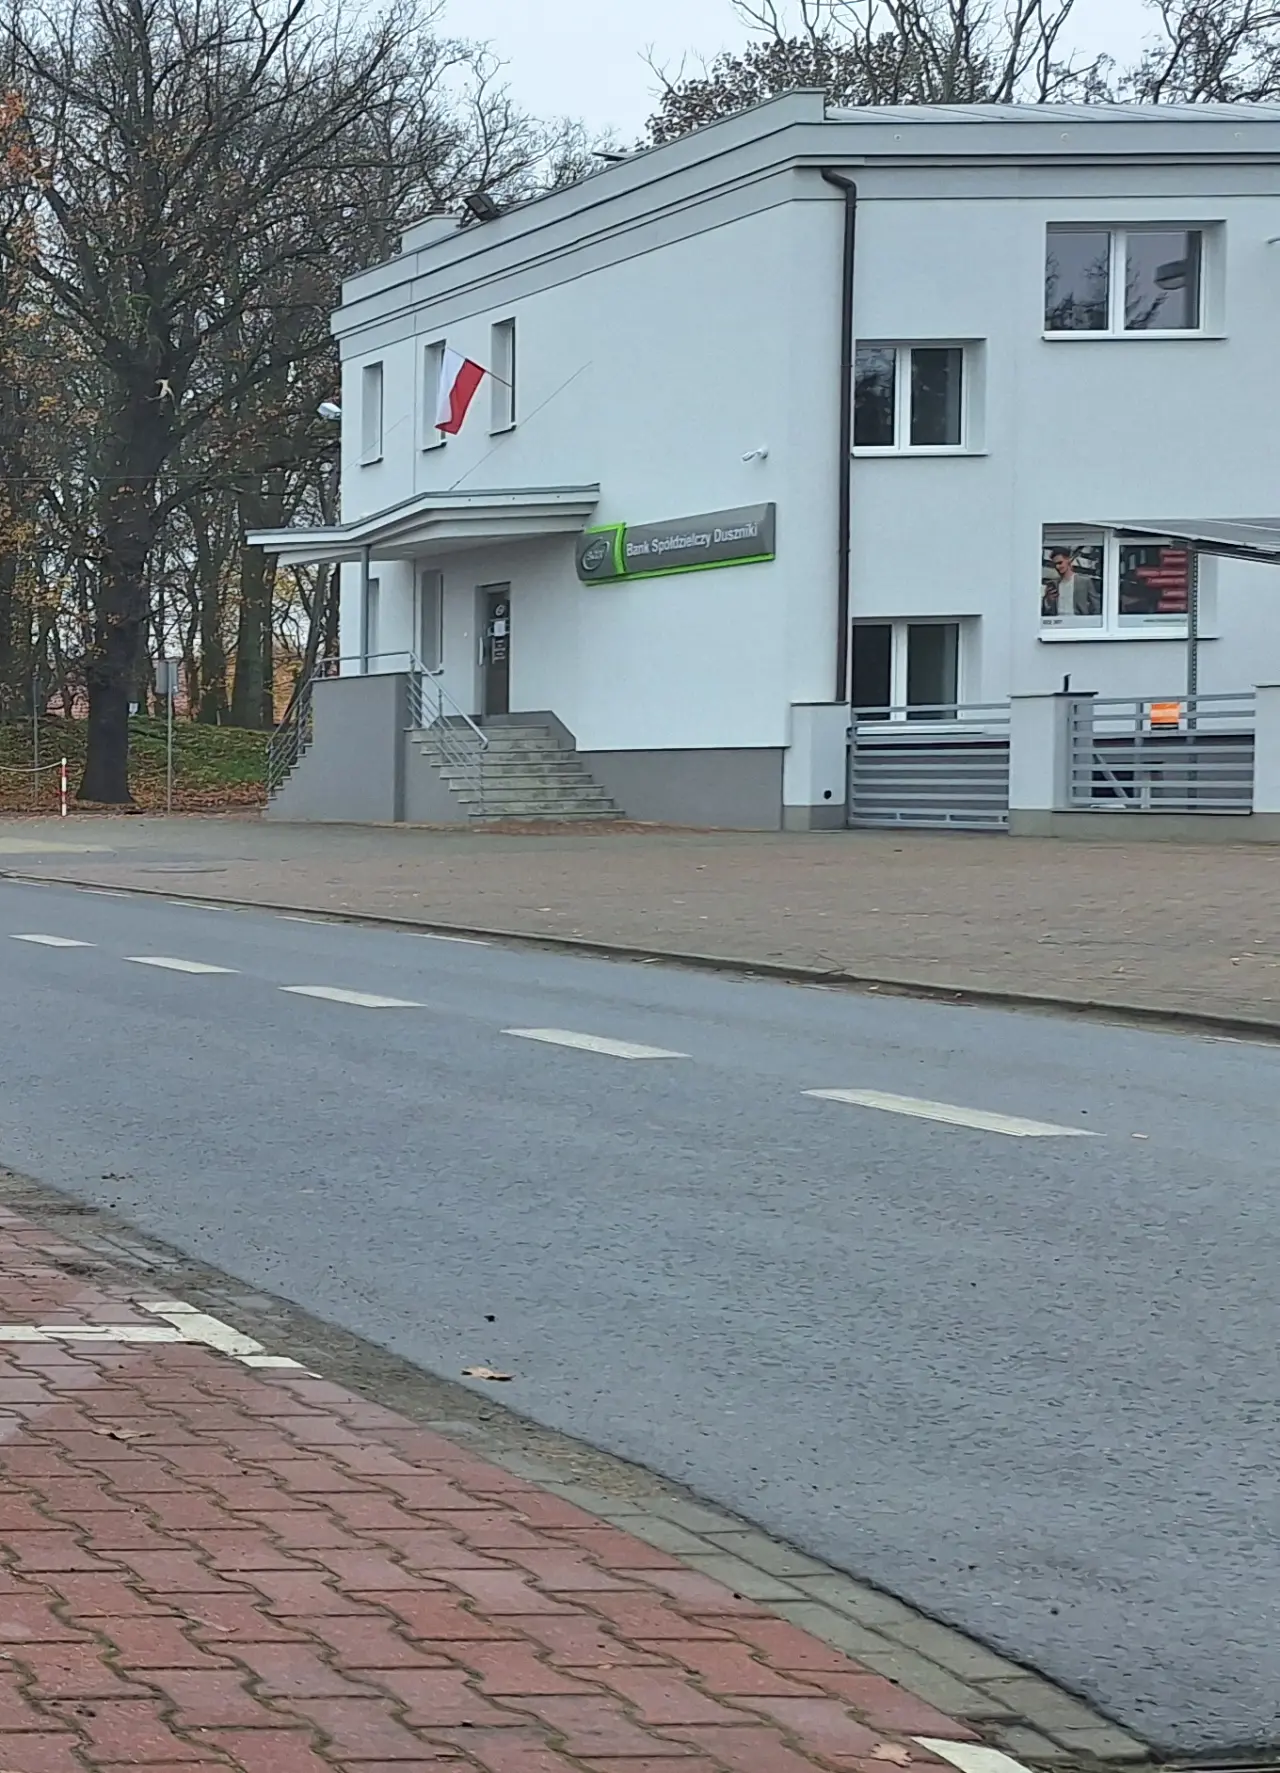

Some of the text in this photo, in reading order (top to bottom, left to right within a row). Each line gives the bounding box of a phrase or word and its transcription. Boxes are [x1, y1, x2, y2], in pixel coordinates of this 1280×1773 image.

[626, 541, 650, 557] Bank
[651, 532, 712, 555] Spółdzielczy
[713, 522, 758, 543] Duszniki
